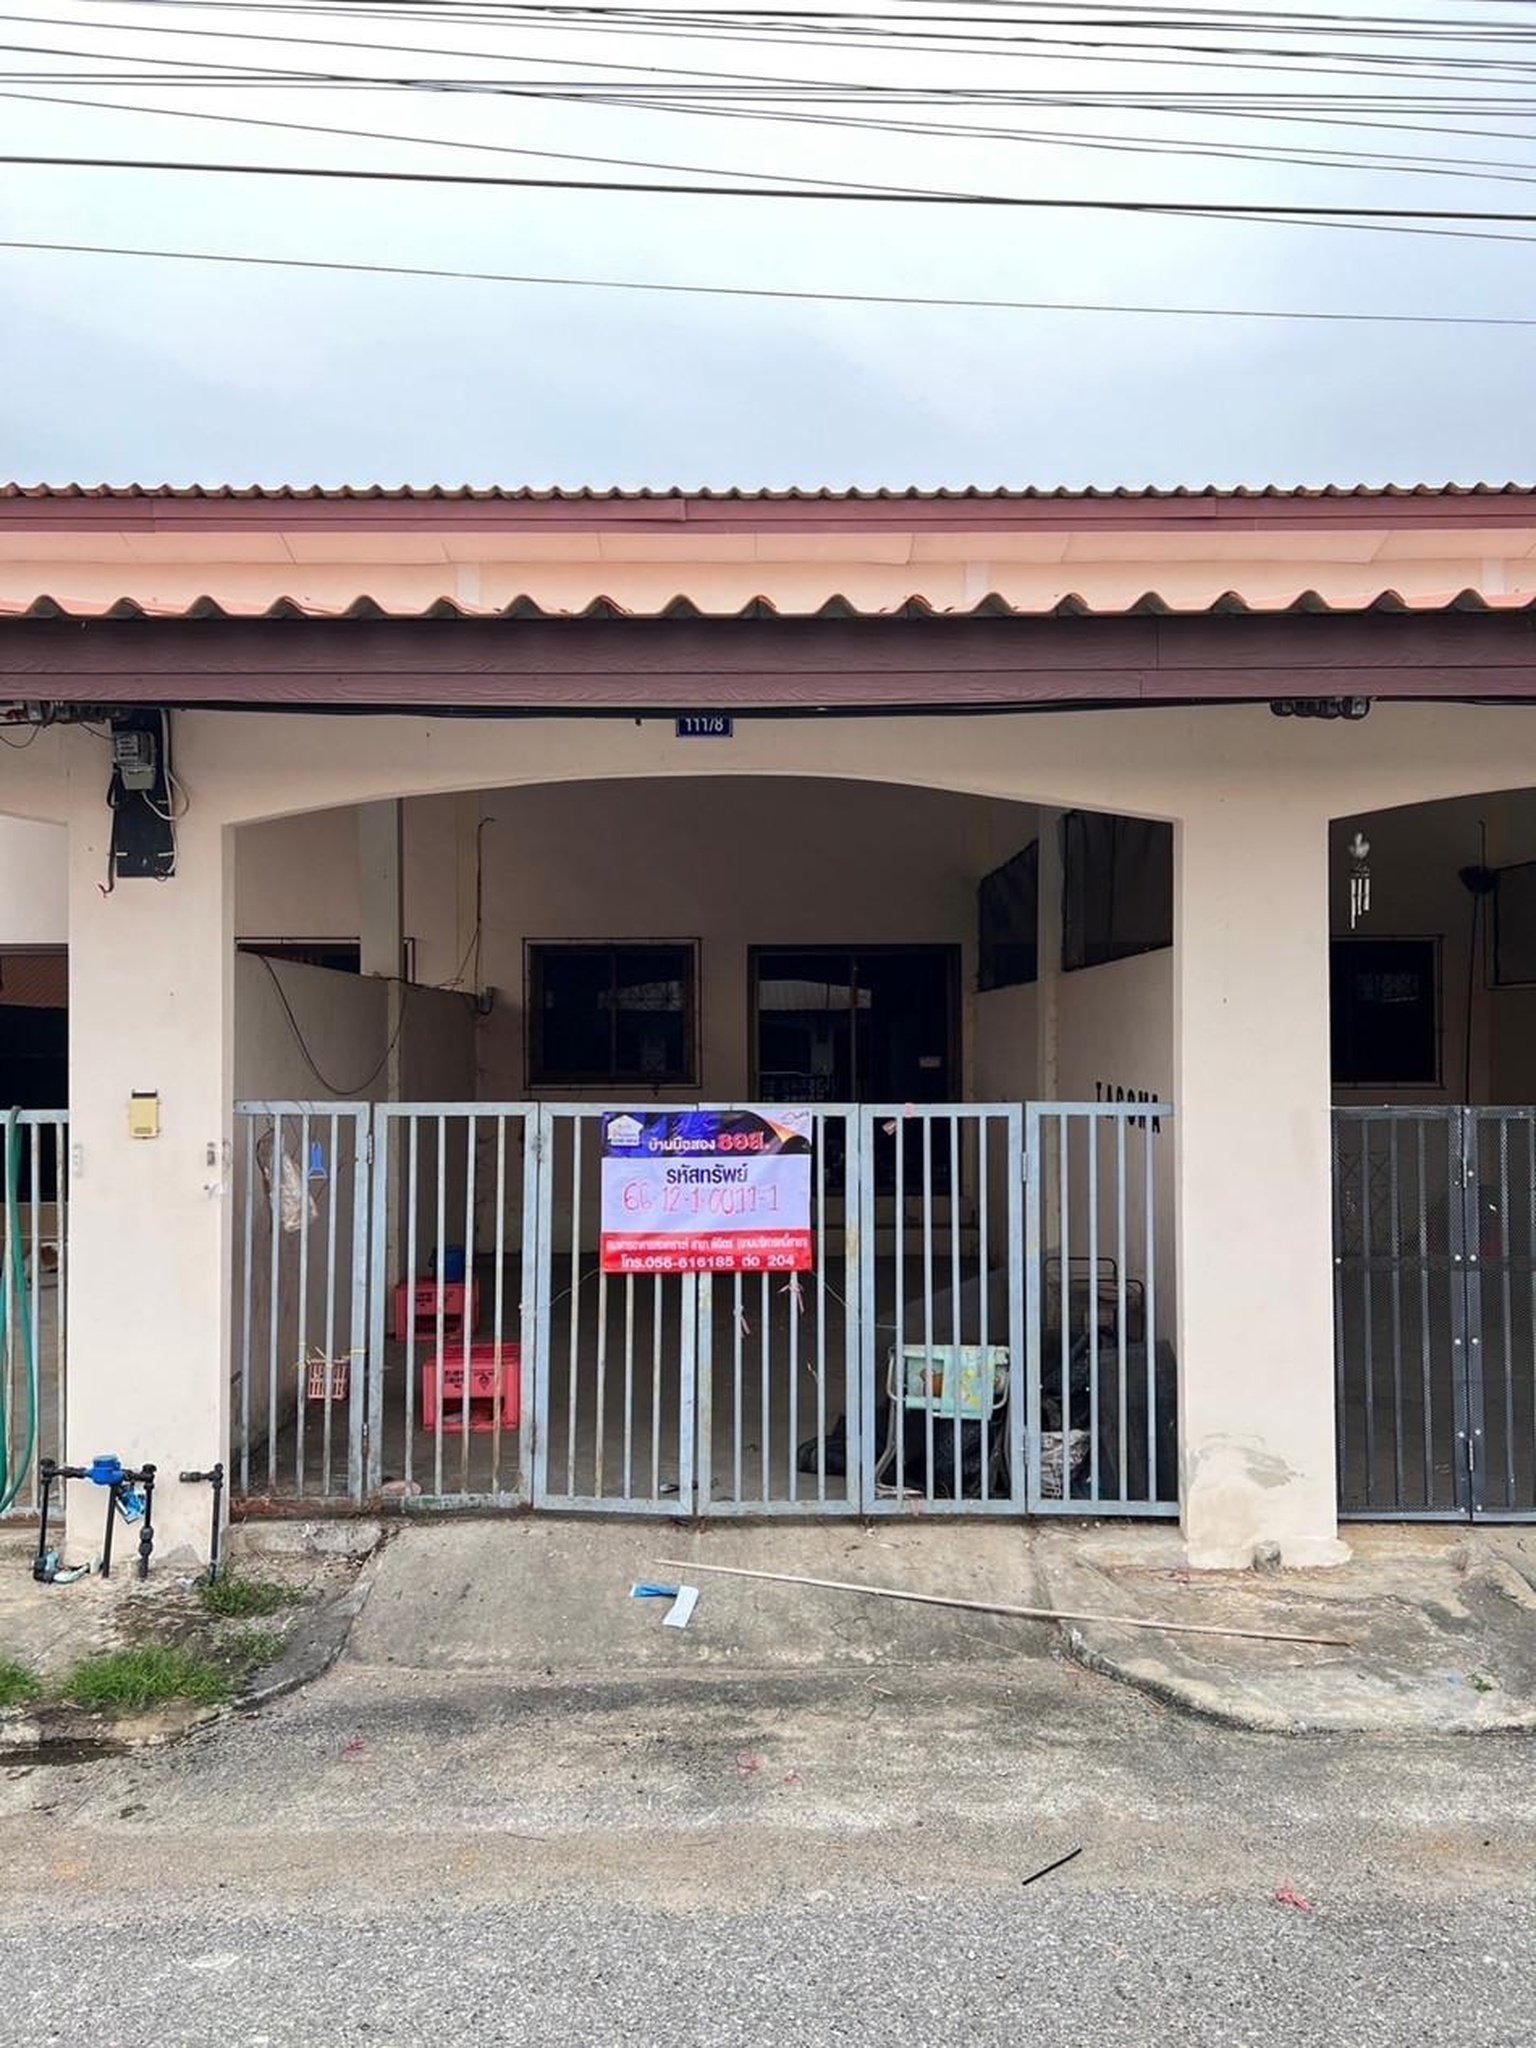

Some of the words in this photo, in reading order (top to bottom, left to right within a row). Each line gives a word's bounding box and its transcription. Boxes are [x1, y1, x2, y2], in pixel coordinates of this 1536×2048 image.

[685, 717, 724, 732] 111/8
[666, 1163, 748, 1184] รหัสทรัพย์
[767, 1253, 795, 1267] 204
